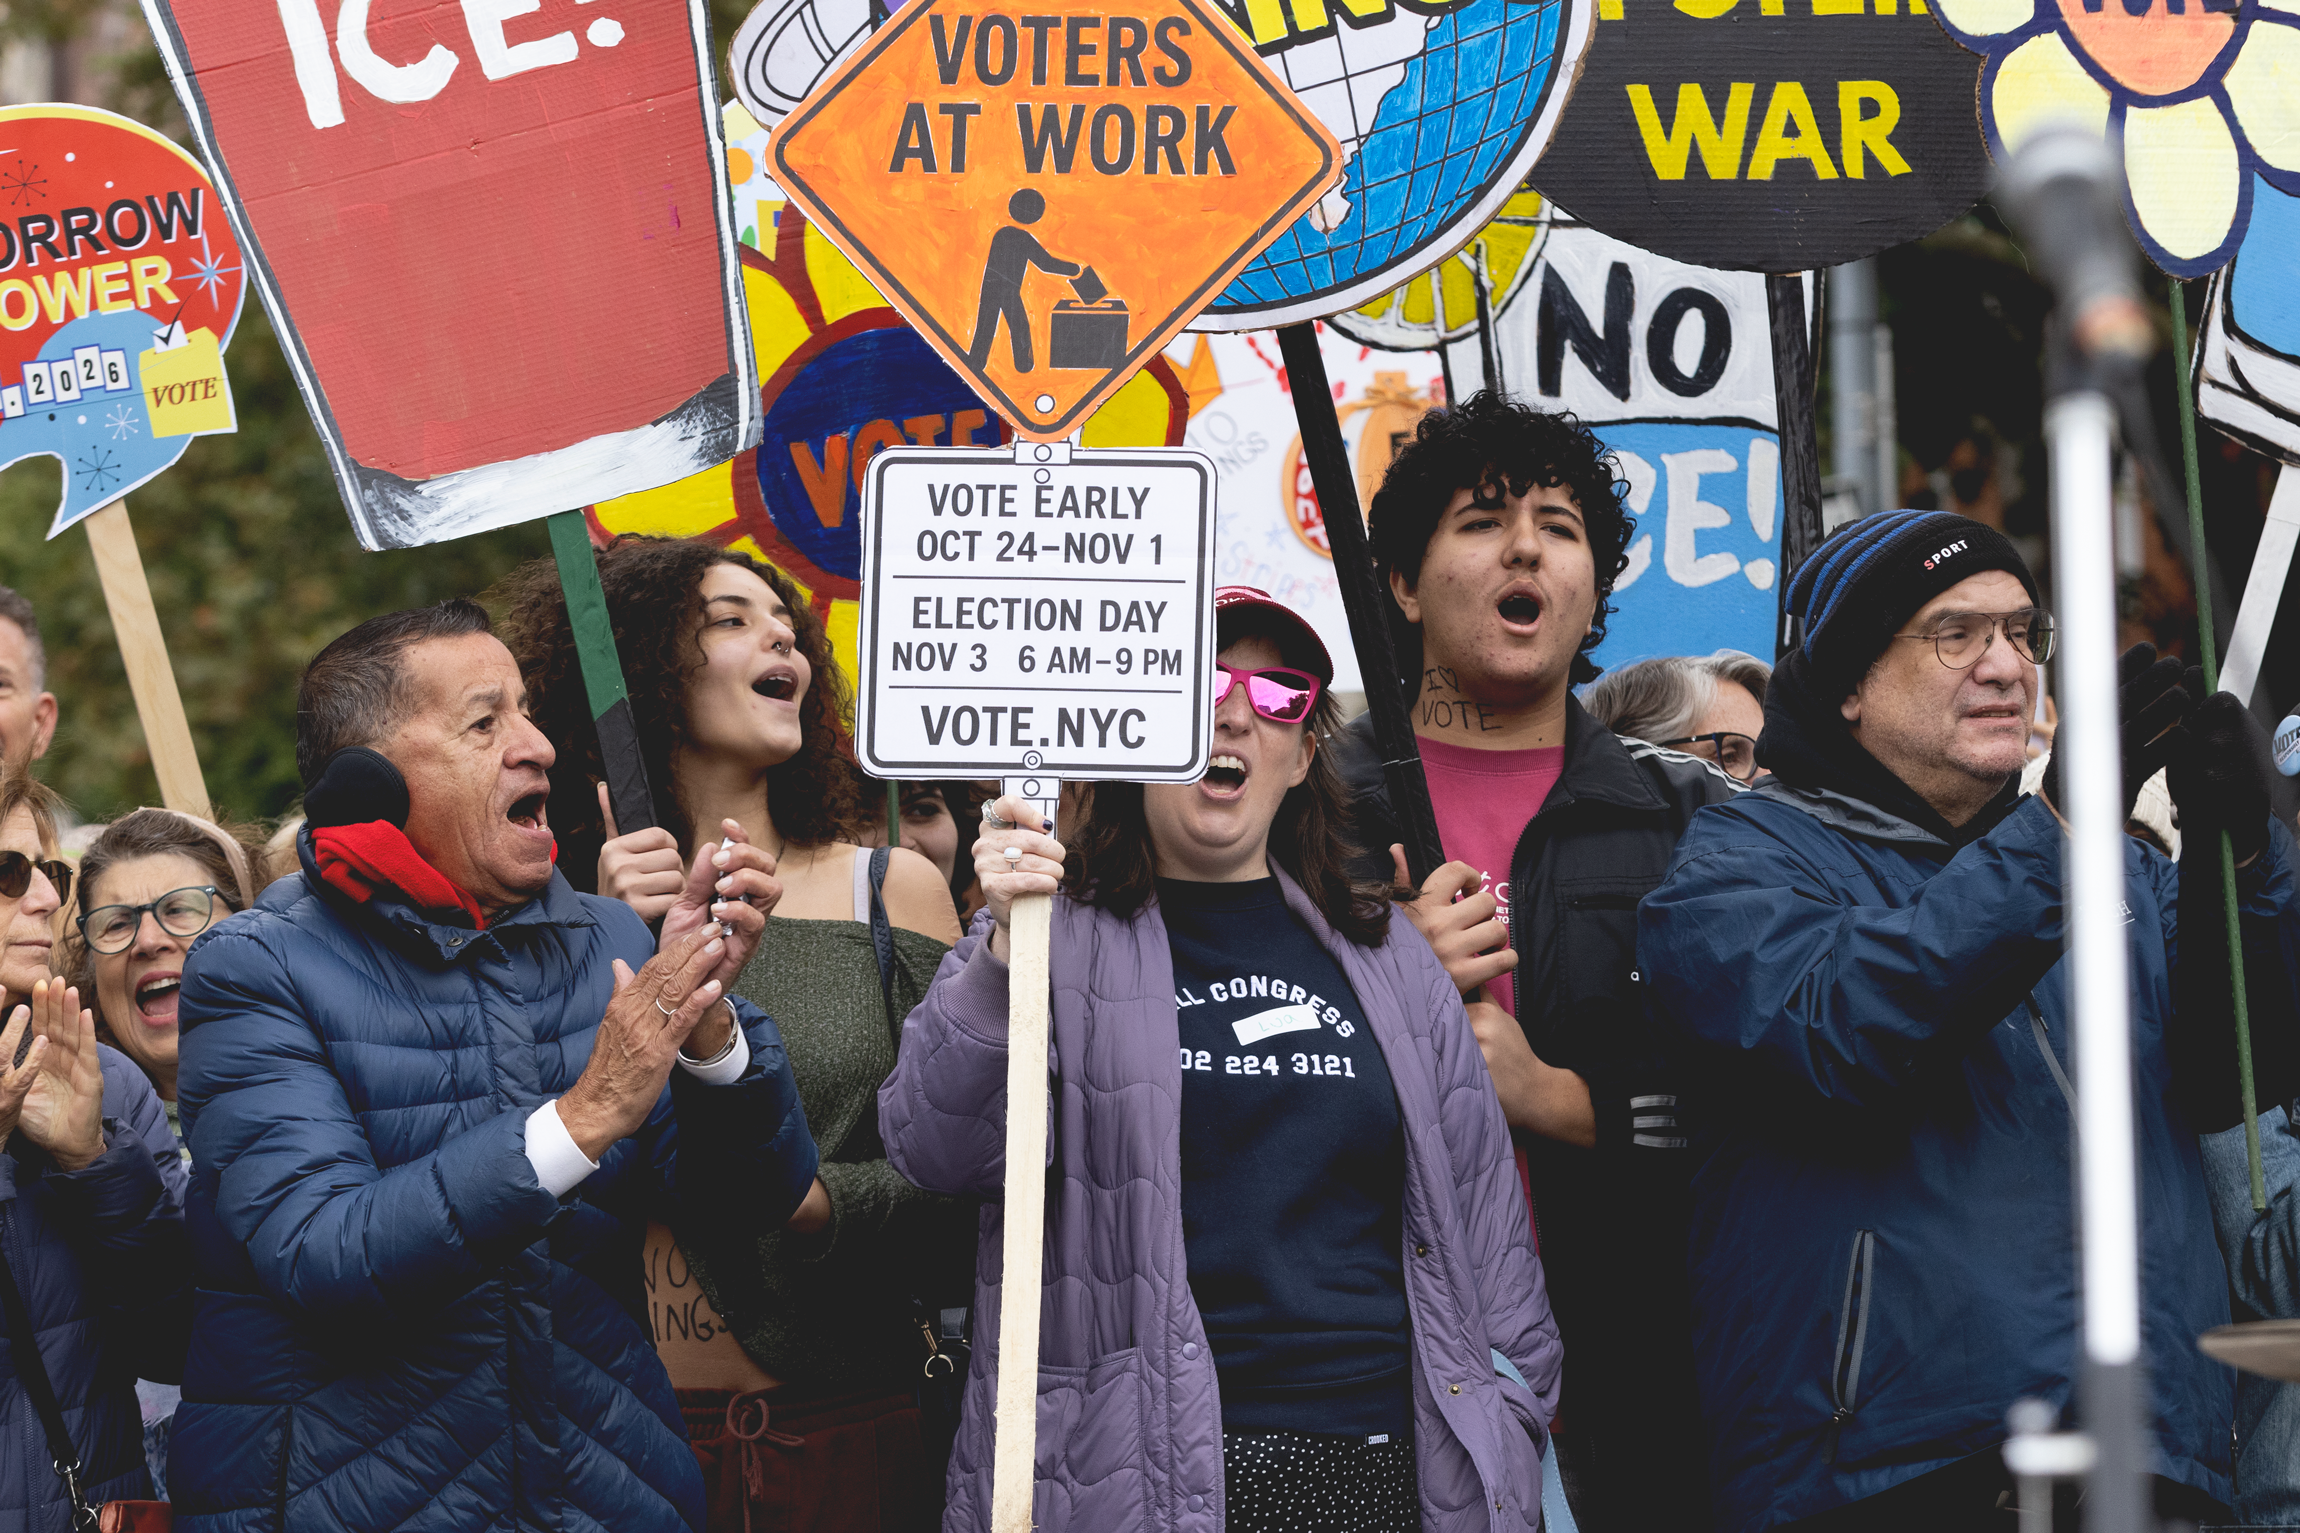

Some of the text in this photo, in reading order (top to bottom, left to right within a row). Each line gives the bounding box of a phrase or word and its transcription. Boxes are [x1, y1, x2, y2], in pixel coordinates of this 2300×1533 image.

[929, 13, 1194, 88] VOTERS
[889, 103, 1238, 177] AT WORK
[1625, 80, 1912, 181] WAR
[1537, 261, 1732, 402] NO
[152, 377, 217, 409] VOTE
[927, 483, 1151, 519] VOTE EARLY
[917, 529, 982, 562] OCT
[1150, 534, 1162, 565] 1
[1923, 539, 1969, 571] SPORT
[912, 596, 1168, 633] ELECTION DAY
[892, 641, 957, 672] NOV
[969, 643, 988, 672] 3
[1018, 645, 1036, 673] 6
[1143, 649, 1182, 676] PM
[921, 705, 1146, 749] VOTE.NYC
[1422, 700, 1504, 731] VOTE
[1209, 975, 1355, 1038] CONGRESS
[1225, 1055, 1279, 1076] 224
[1290, 1052, 1356, 1078] 3121
